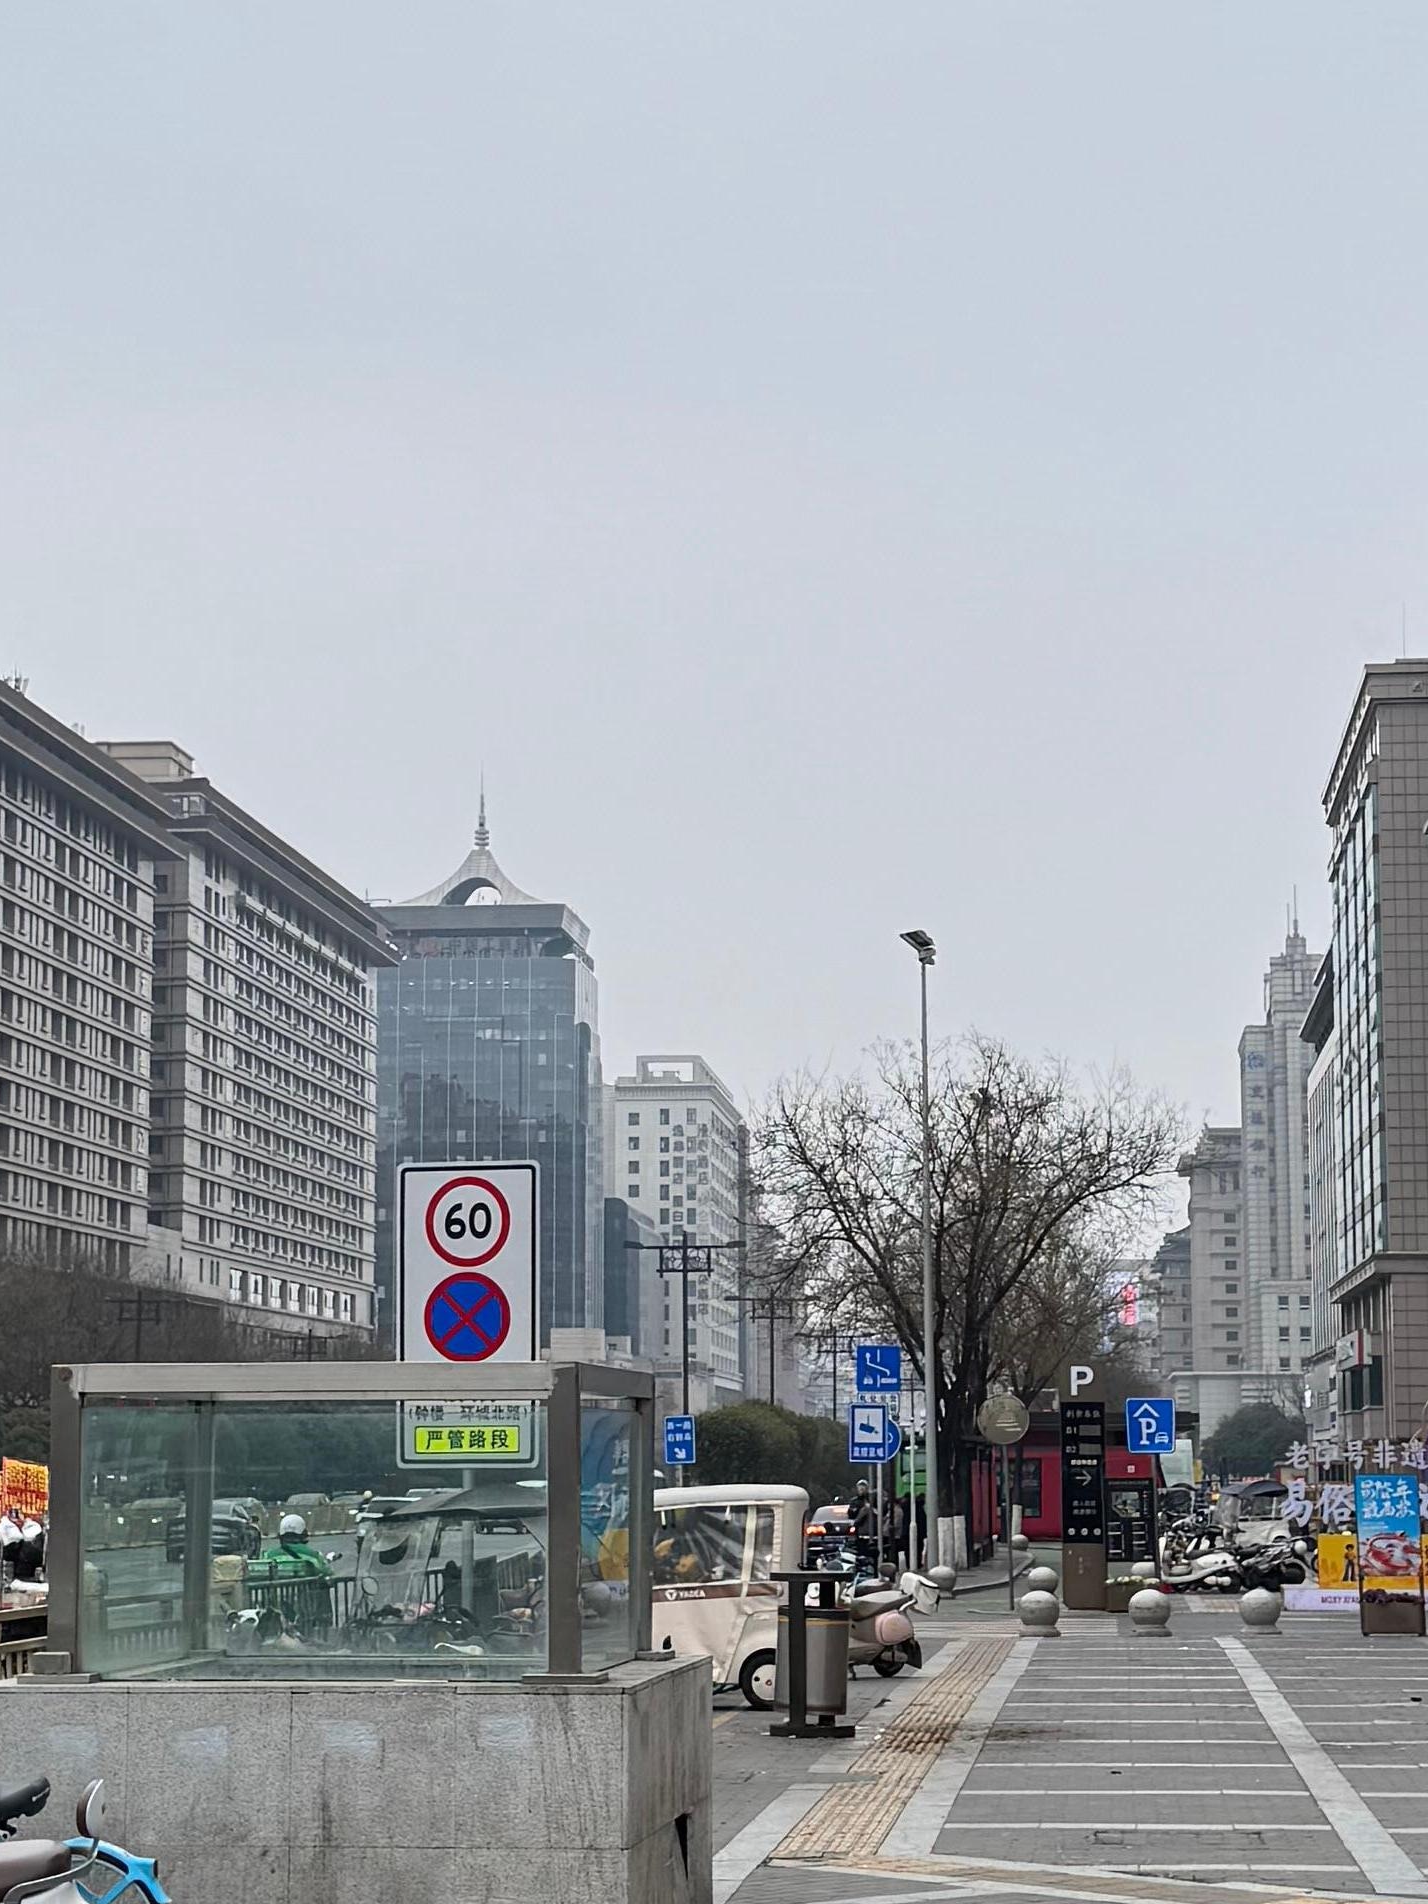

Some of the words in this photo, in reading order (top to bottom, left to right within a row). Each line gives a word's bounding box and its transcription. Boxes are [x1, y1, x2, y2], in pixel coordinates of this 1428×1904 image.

[443, 1202, 492, 1240] 60
[1070, 1365, 1094, 1396] P
[425, 1429, 509, 1450] 严管路段
[1138, 1418, 1157, 1445] P
